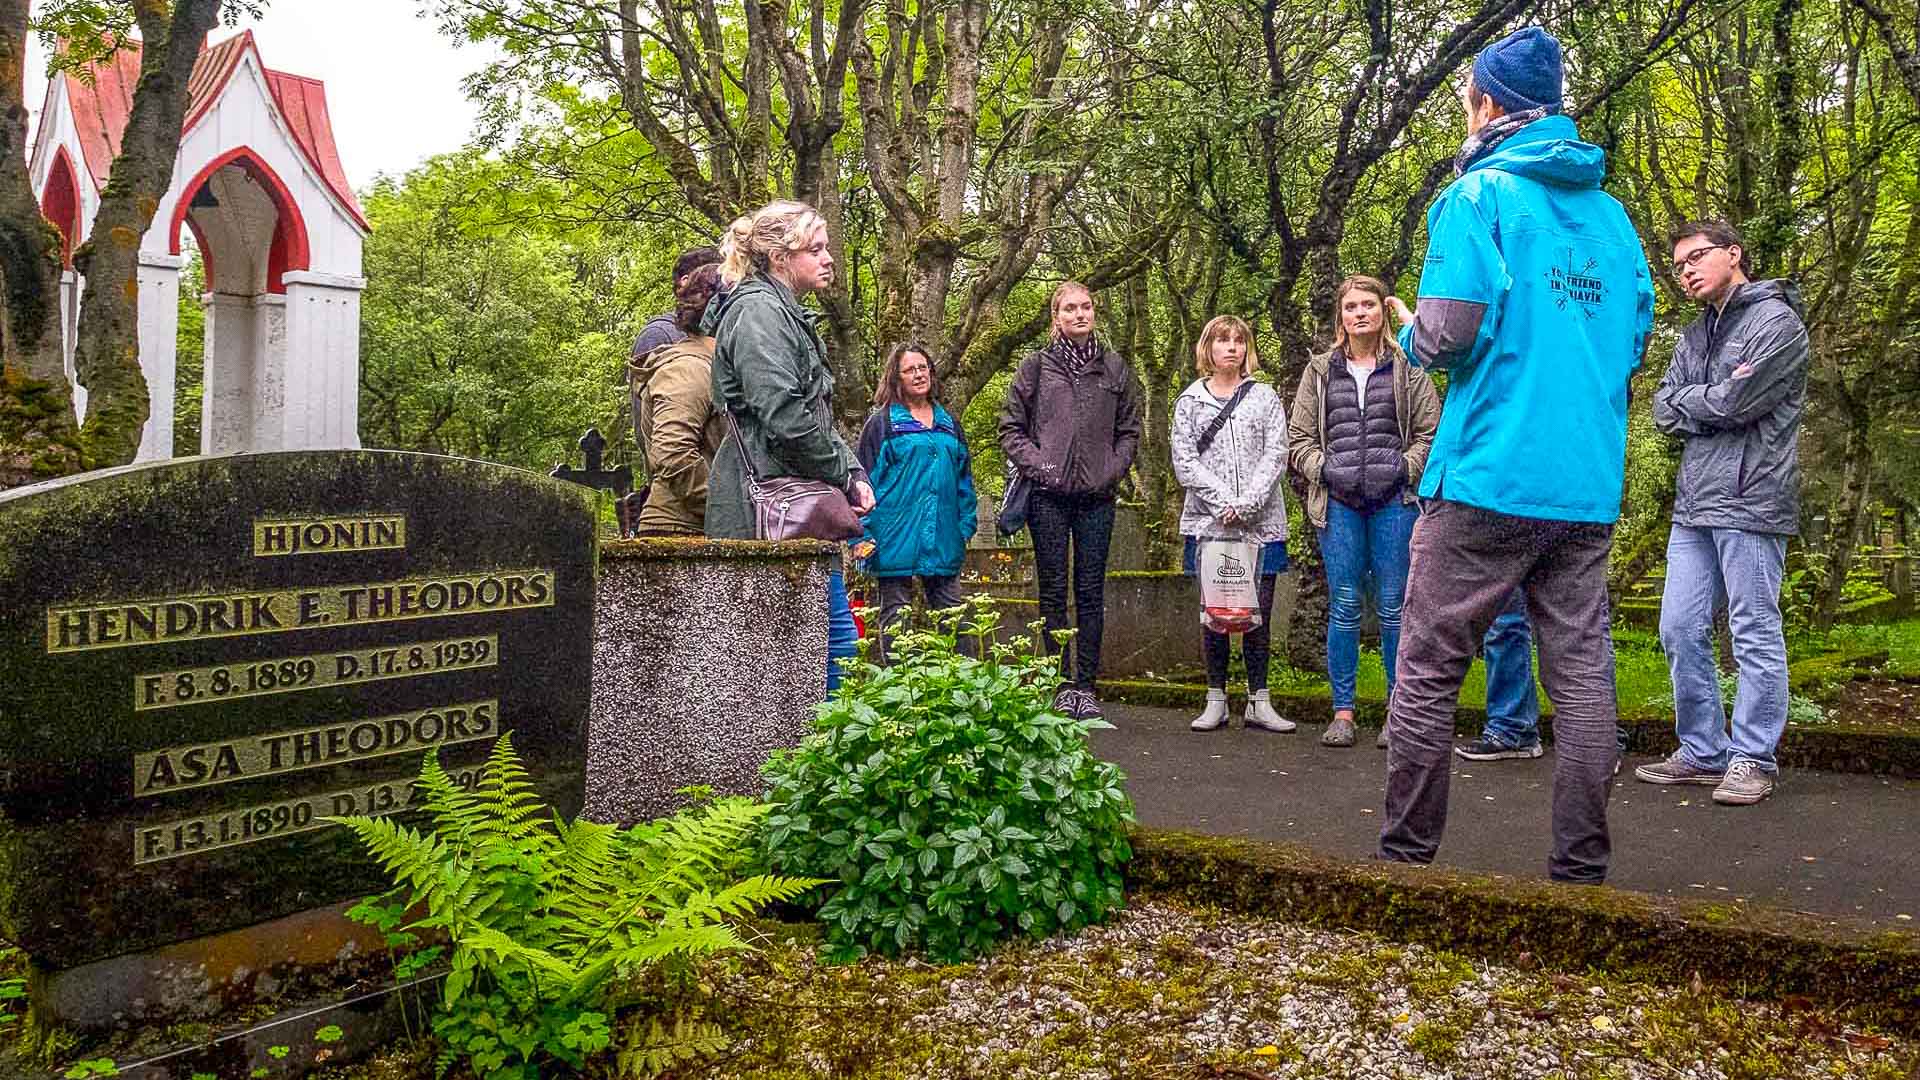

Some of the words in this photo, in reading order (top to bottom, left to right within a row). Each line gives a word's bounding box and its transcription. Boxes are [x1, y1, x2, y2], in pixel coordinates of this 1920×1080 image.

[1567, 276, 1602, 290] FRIEND
[57, 596, 282, 648] HENDRIK
[300, 592, 330, 623] E.
